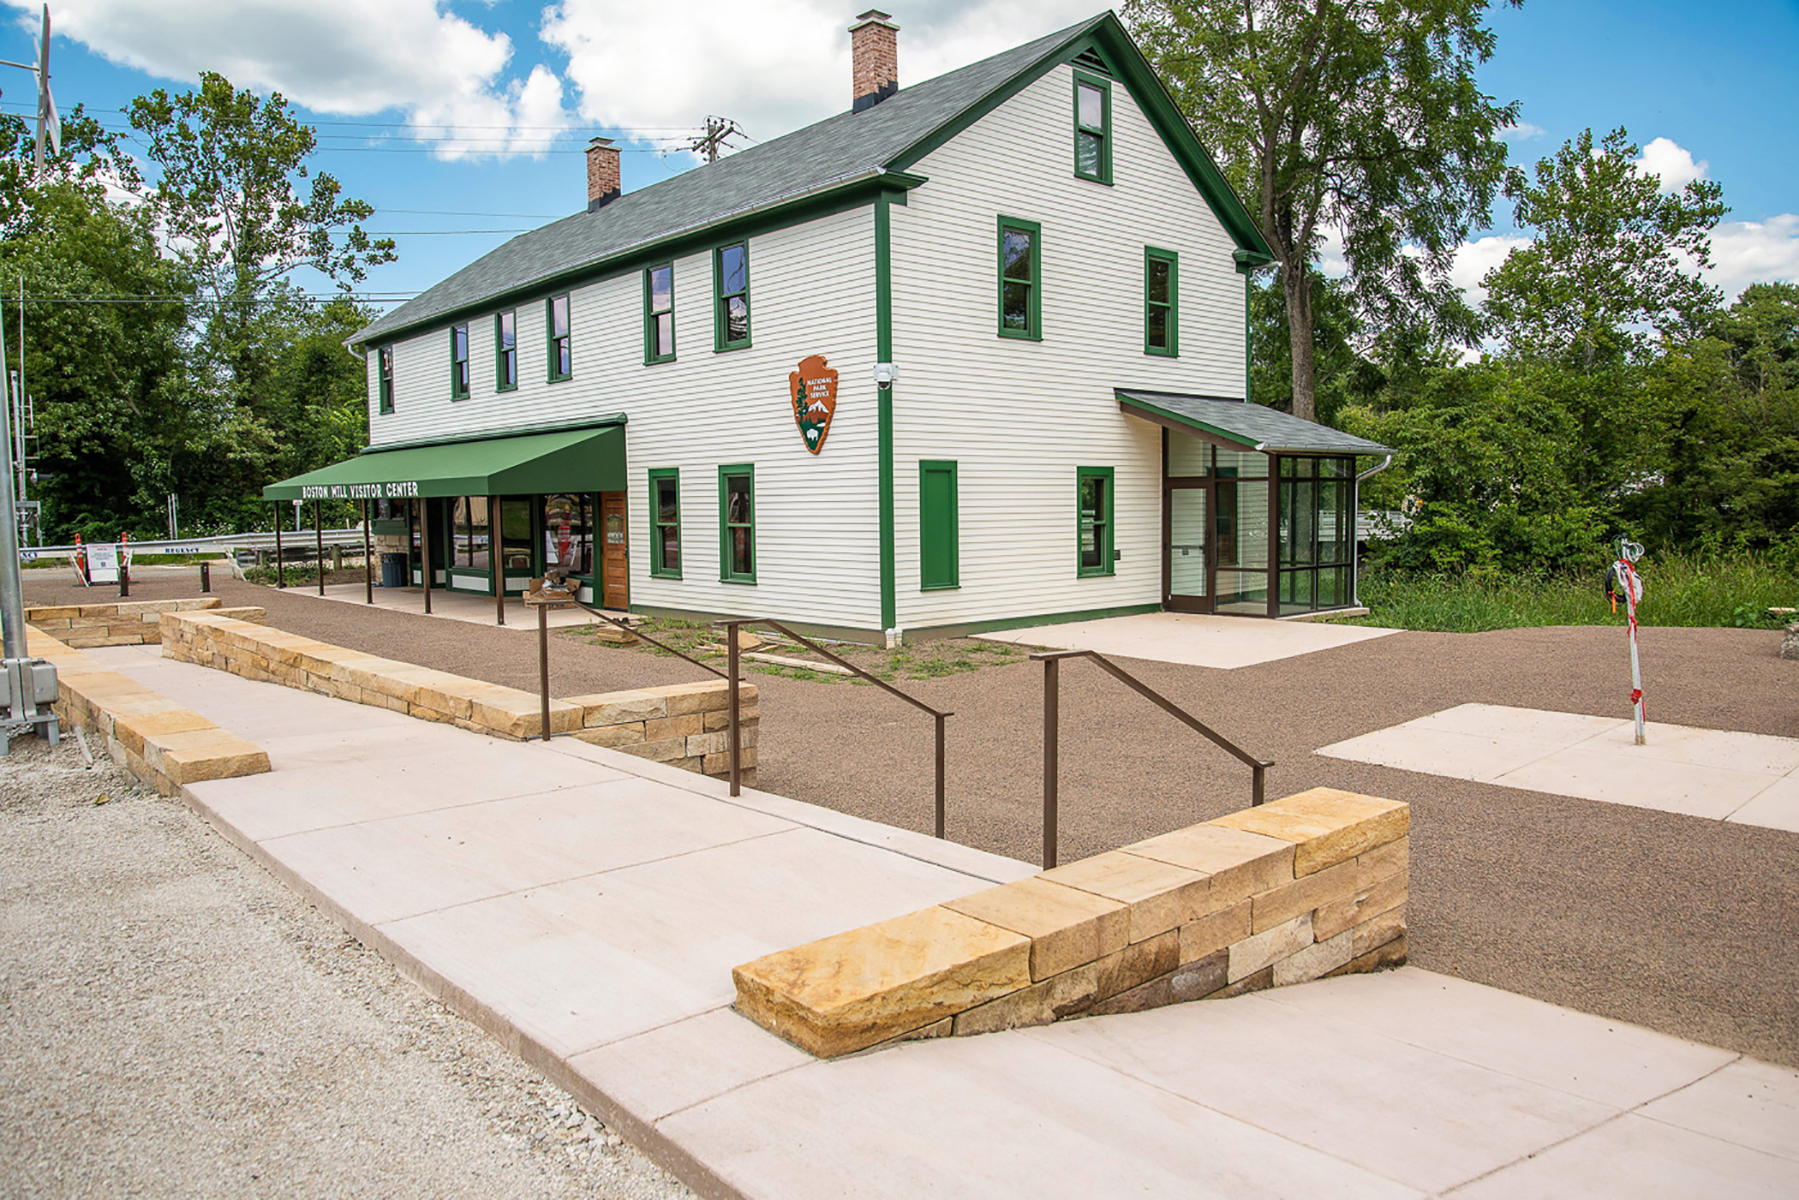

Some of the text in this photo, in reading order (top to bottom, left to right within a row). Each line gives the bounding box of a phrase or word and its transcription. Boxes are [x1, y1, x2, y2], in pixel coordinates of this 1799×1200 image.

[302, 482, 419, 499] BOSTON MILL VISITOR CENTER
